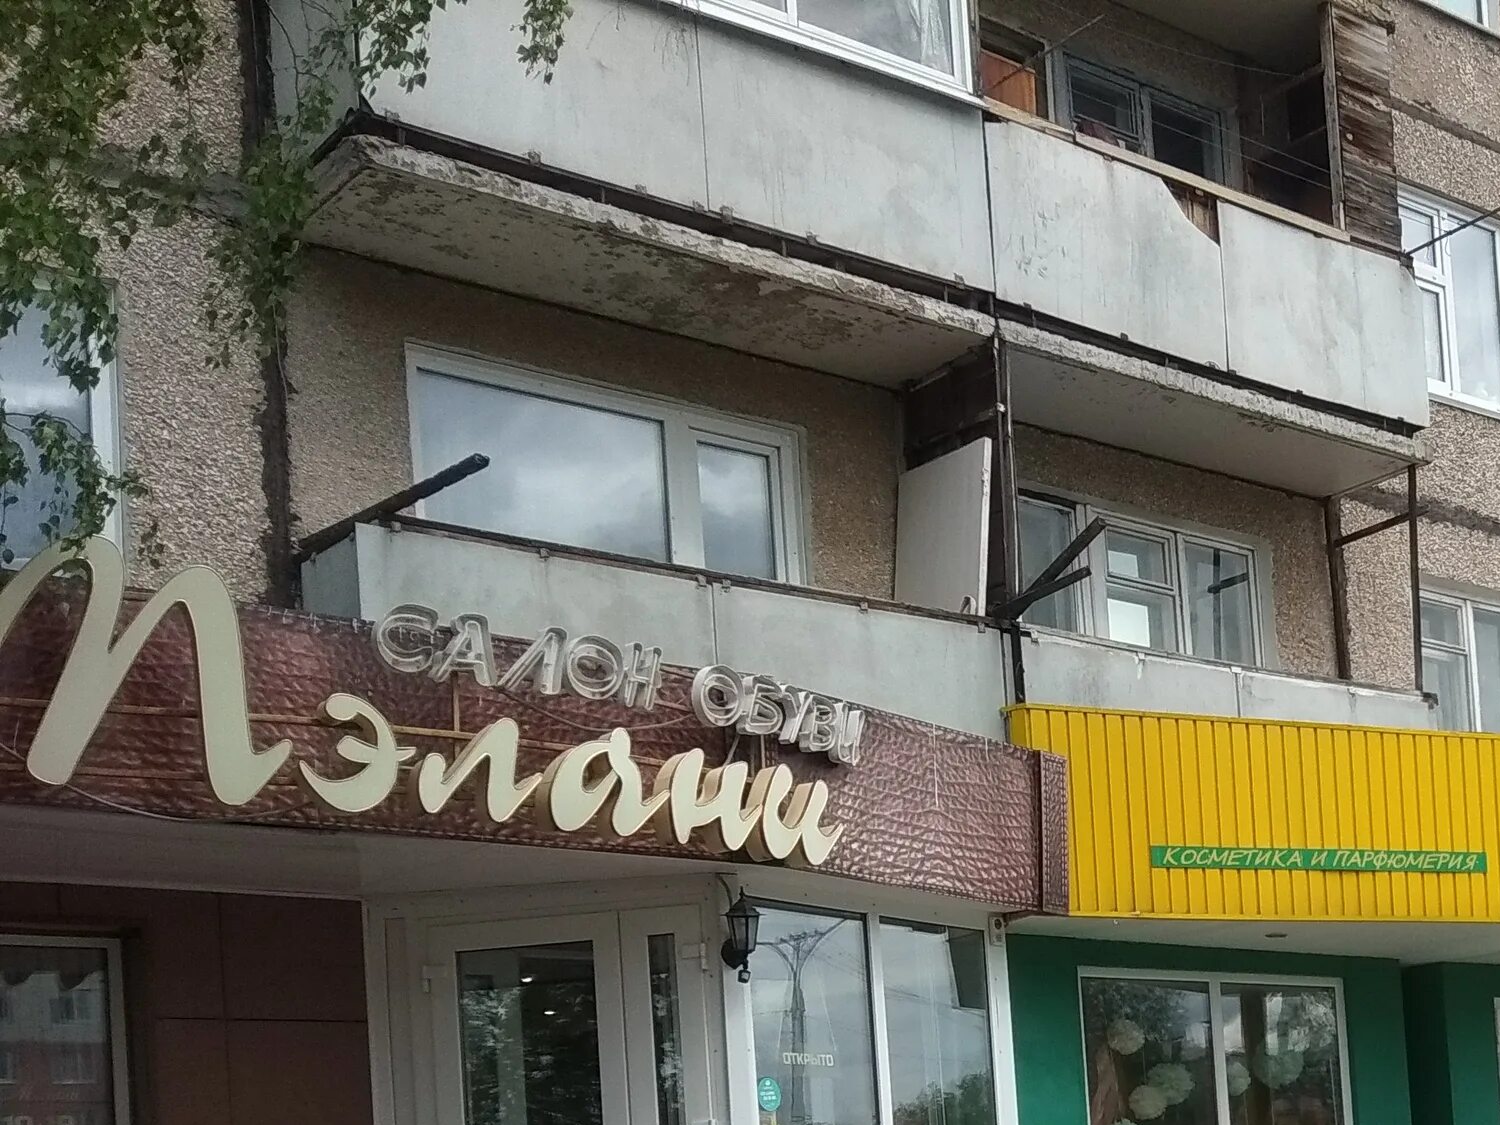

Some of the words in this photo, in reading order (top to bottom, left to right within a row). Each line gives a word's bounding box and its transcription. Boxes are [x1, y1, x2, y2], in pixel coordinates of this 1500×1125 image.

[375, 604, 662, 710] САЛОН
[691, 664, 866, 768] ОБУВИ
[1162, 847, 1302, 867] КОСМЕТИКА
[1310, 850, 1327, 866] И
[1332, 850, 1479, 871] ПАРФЮМЕРИЯ
[783, 1052, 834, 1067] ОТКРЫТО
